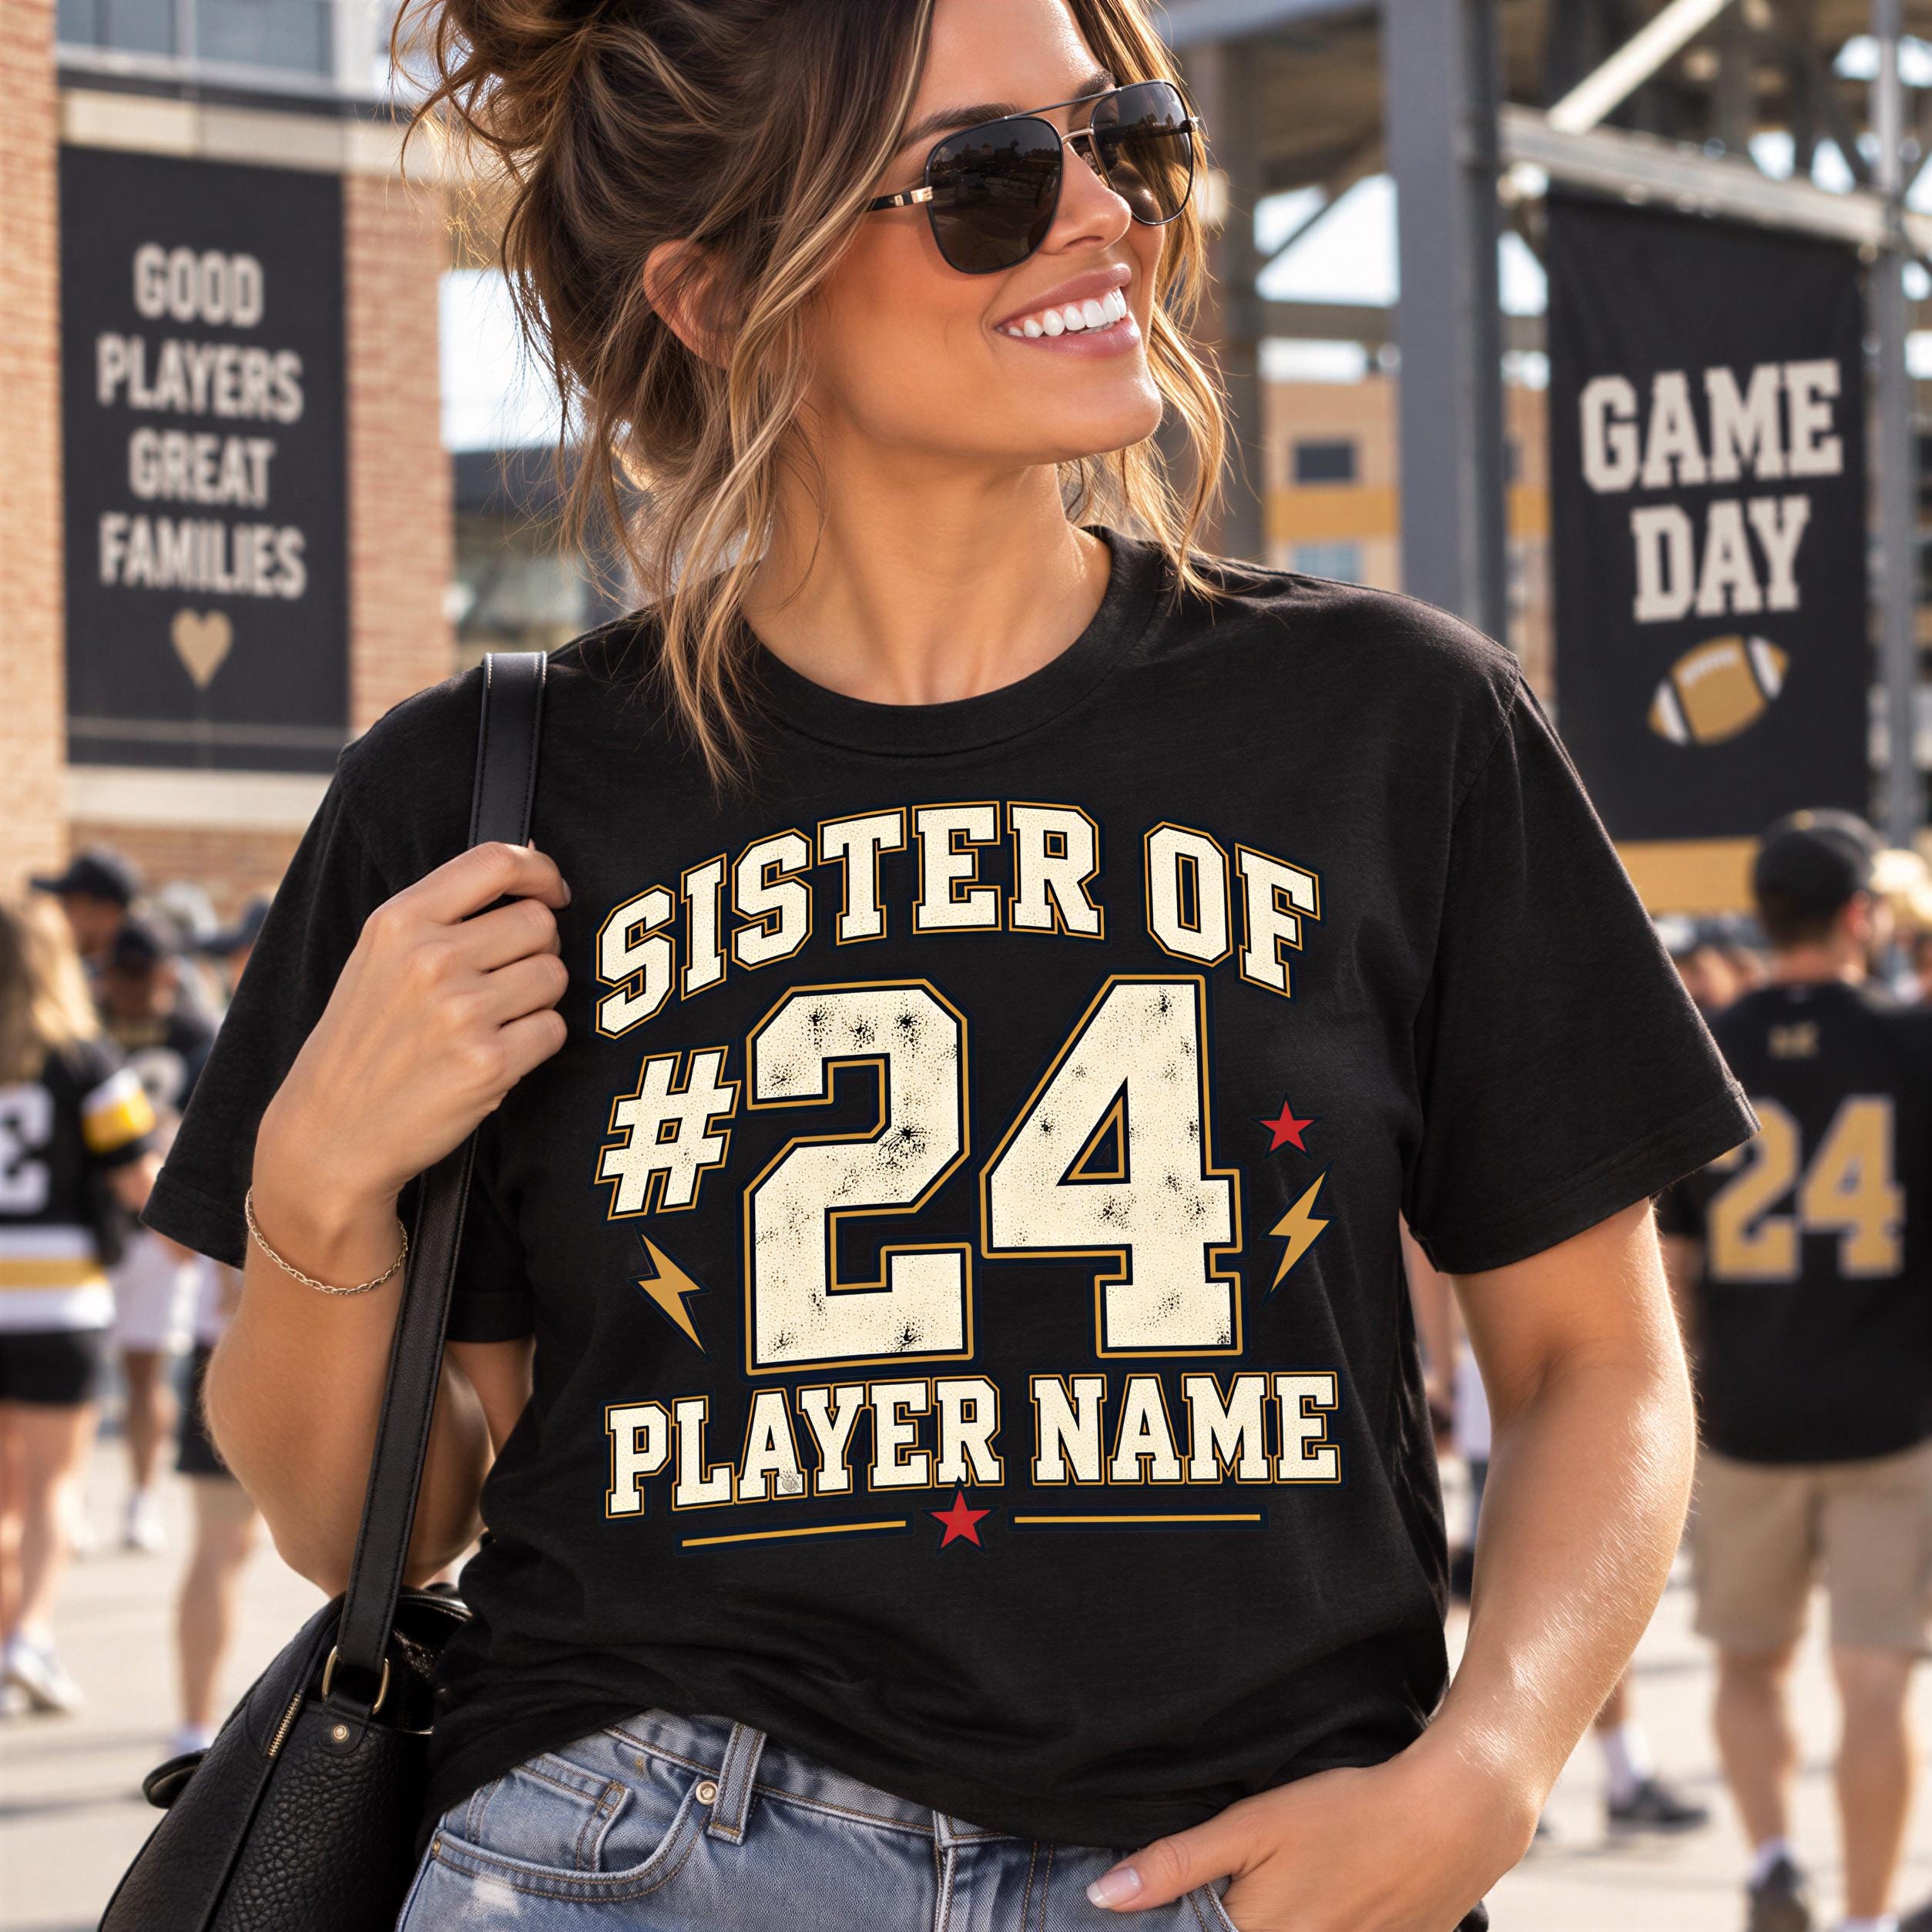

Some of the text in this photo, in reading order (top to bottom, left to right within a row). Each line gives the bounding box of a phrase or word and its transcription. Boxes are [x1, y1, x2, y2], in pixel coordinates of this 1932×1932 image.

[133, 241, 264, 329] GOOD
[95, 332, 305, 424] PLAYERS
[1580, 359, 1843, 493] GAME
[128, 425, 277, 510] GREAT
[98, 511, 307, 601] FAMILIES
[1631, 495, 1810, 624] DAY
[595, 801, 1320, 1038] SISTER OF
[595, 974, 1243, 1376] #24
[1706, 1095, 1906, 1282] 24
[605, 1371, 1340, 1518] PLAYER NAME
